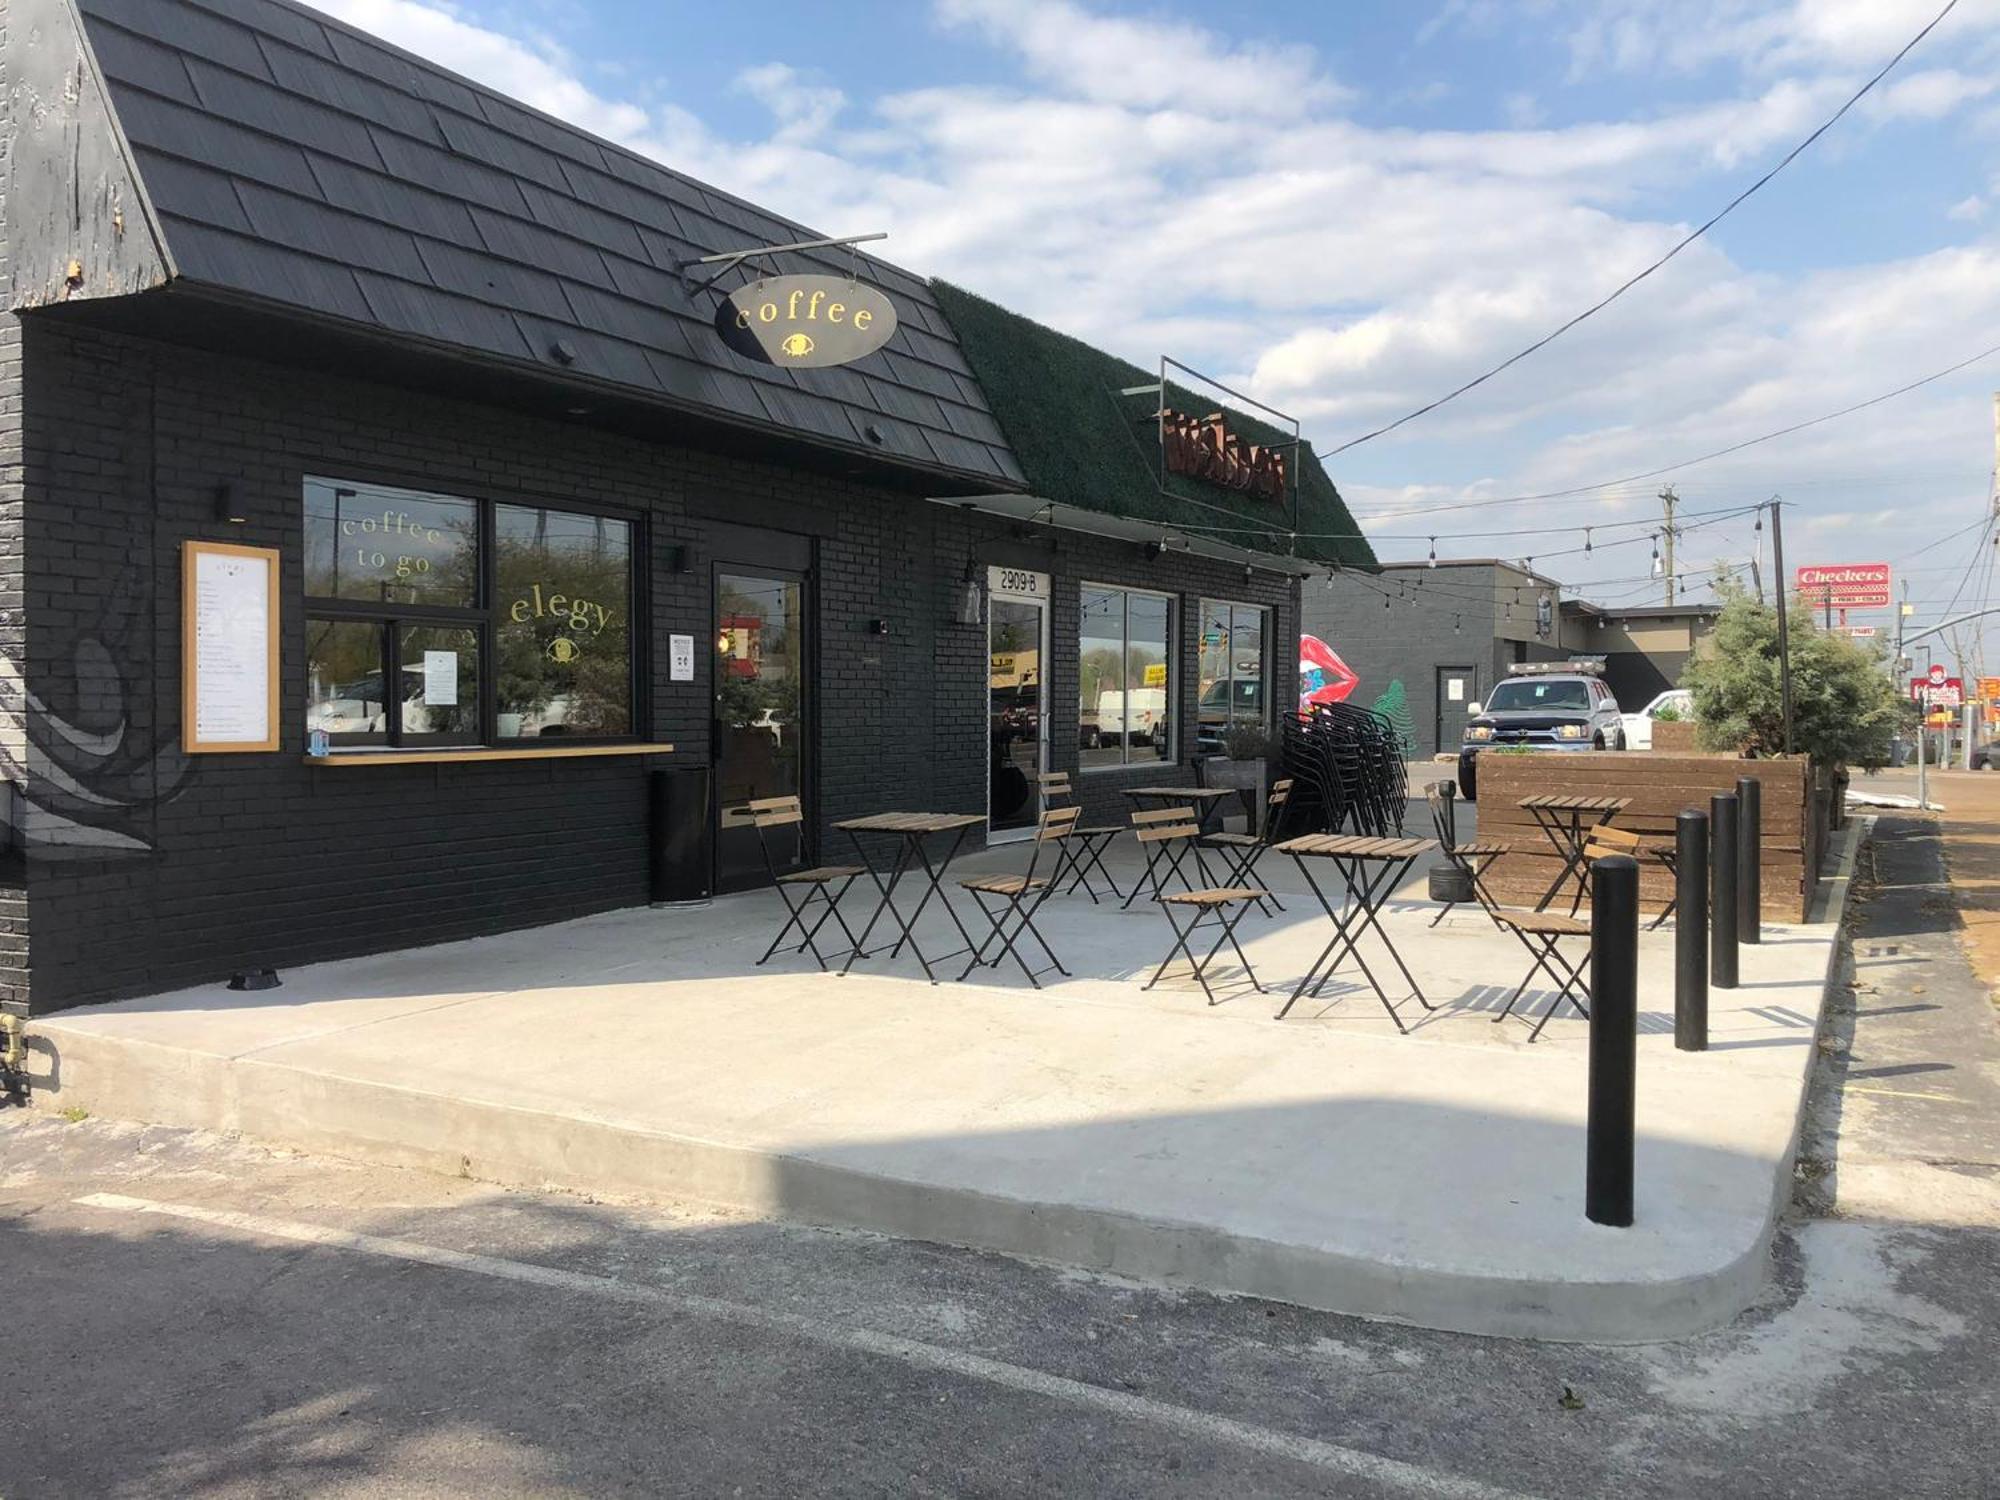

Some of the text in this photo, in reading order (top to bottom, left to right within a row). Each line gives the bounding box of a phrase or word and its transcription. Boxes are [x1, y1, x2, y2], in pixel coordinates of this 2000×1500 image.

[736, 290, 873, 330] coffee
[342, 510, 440, 544] coffee
[357, 549, 429, 577] to go
[1801, 569, 1885, 584] Checkers
[511, 584, 614, 635] elegy
